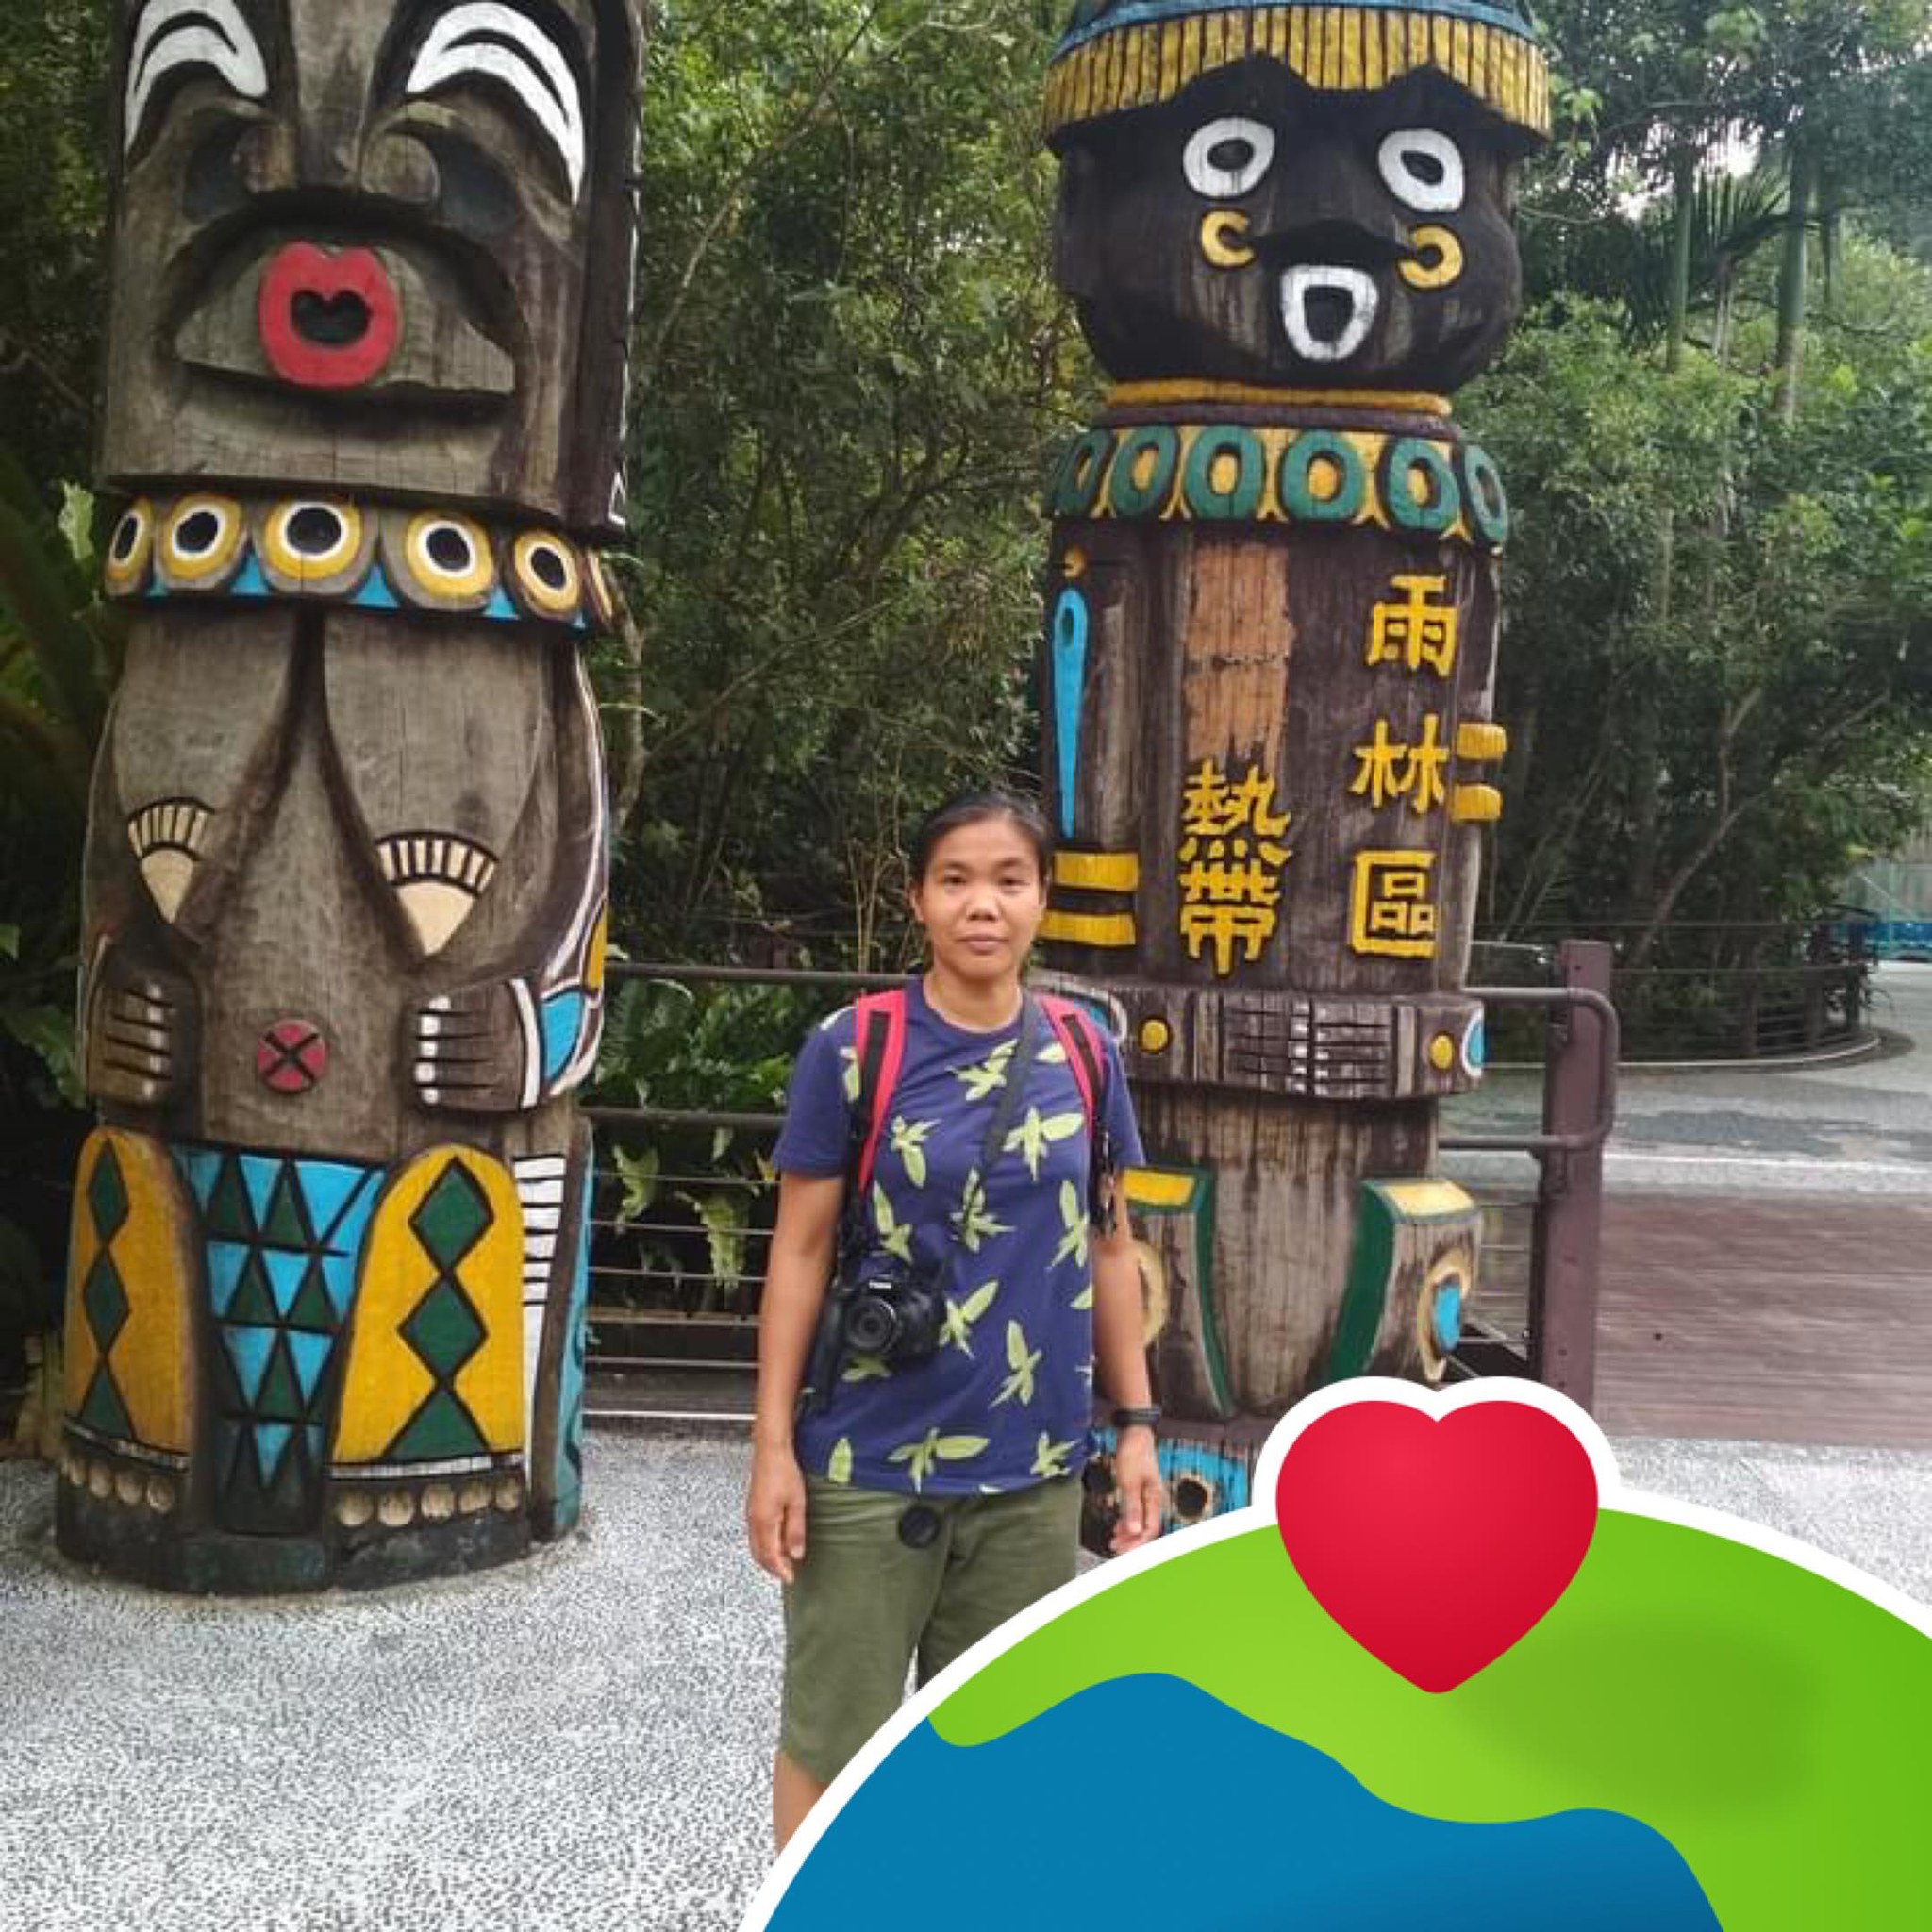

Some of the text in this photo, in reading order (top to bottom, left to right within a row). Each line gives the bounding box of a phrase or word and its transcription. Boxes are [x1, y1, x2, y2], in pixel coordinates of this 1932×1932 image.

[1179, 758, 1291, 975] 熱帶
[1349, 574, 1458, 958] 雨林區
